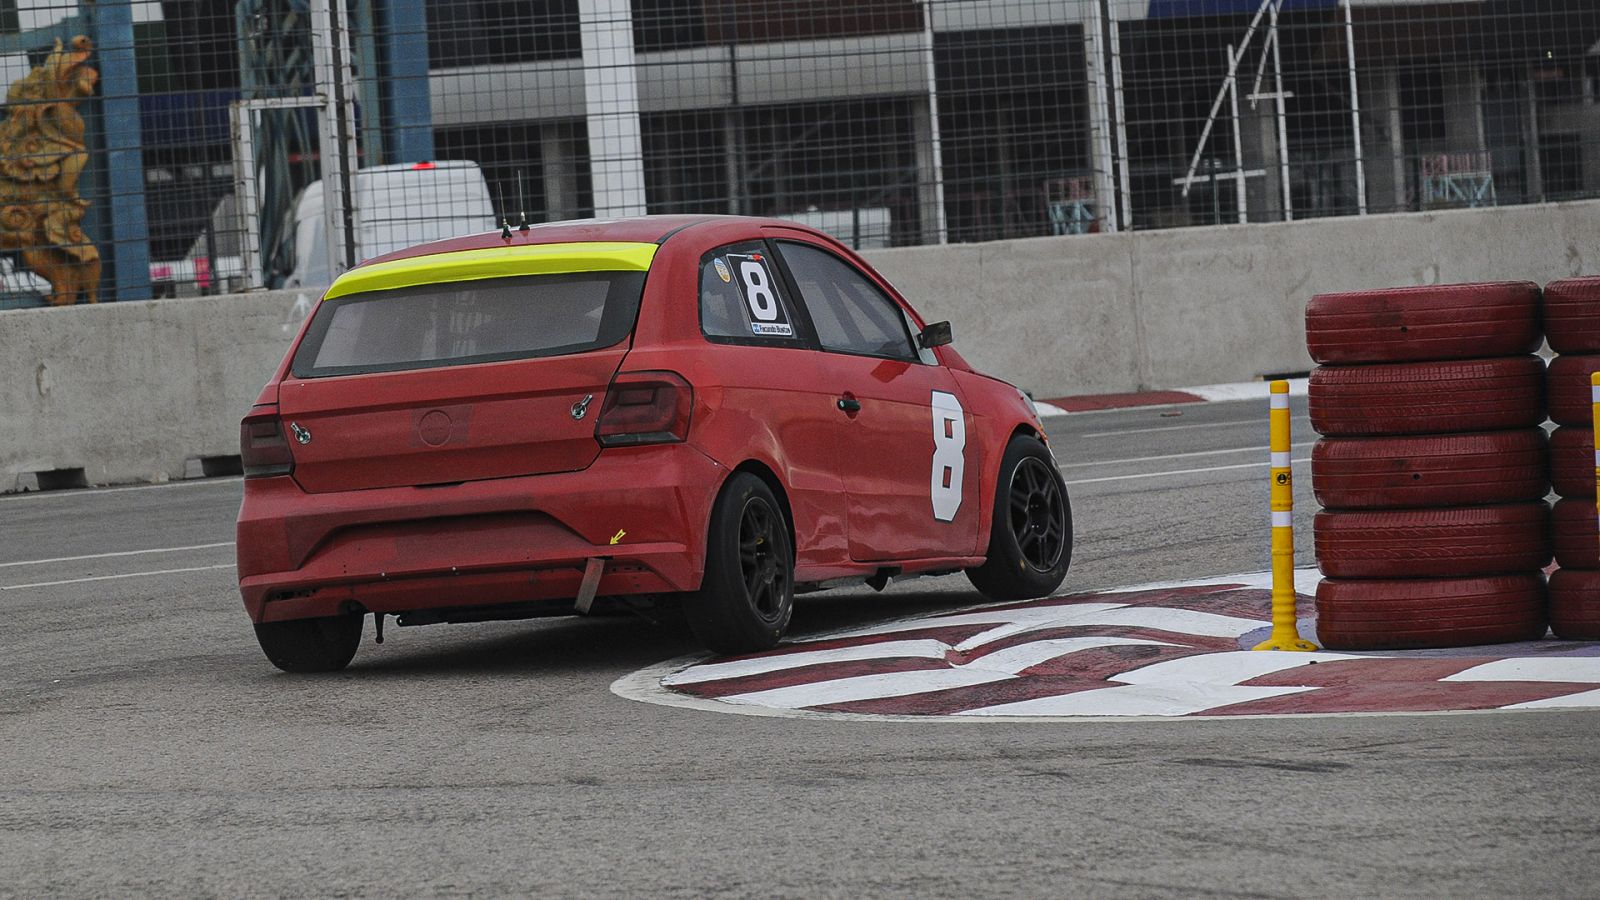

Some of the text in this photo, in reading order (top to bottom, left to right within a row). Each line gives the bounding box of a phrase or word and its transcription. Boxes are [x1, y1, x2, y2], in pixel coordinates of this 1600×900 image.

[741, 261, 777, 320] 8
[759, 324, 776, 333] Facundo
[931, 390, 966, 521] 8
